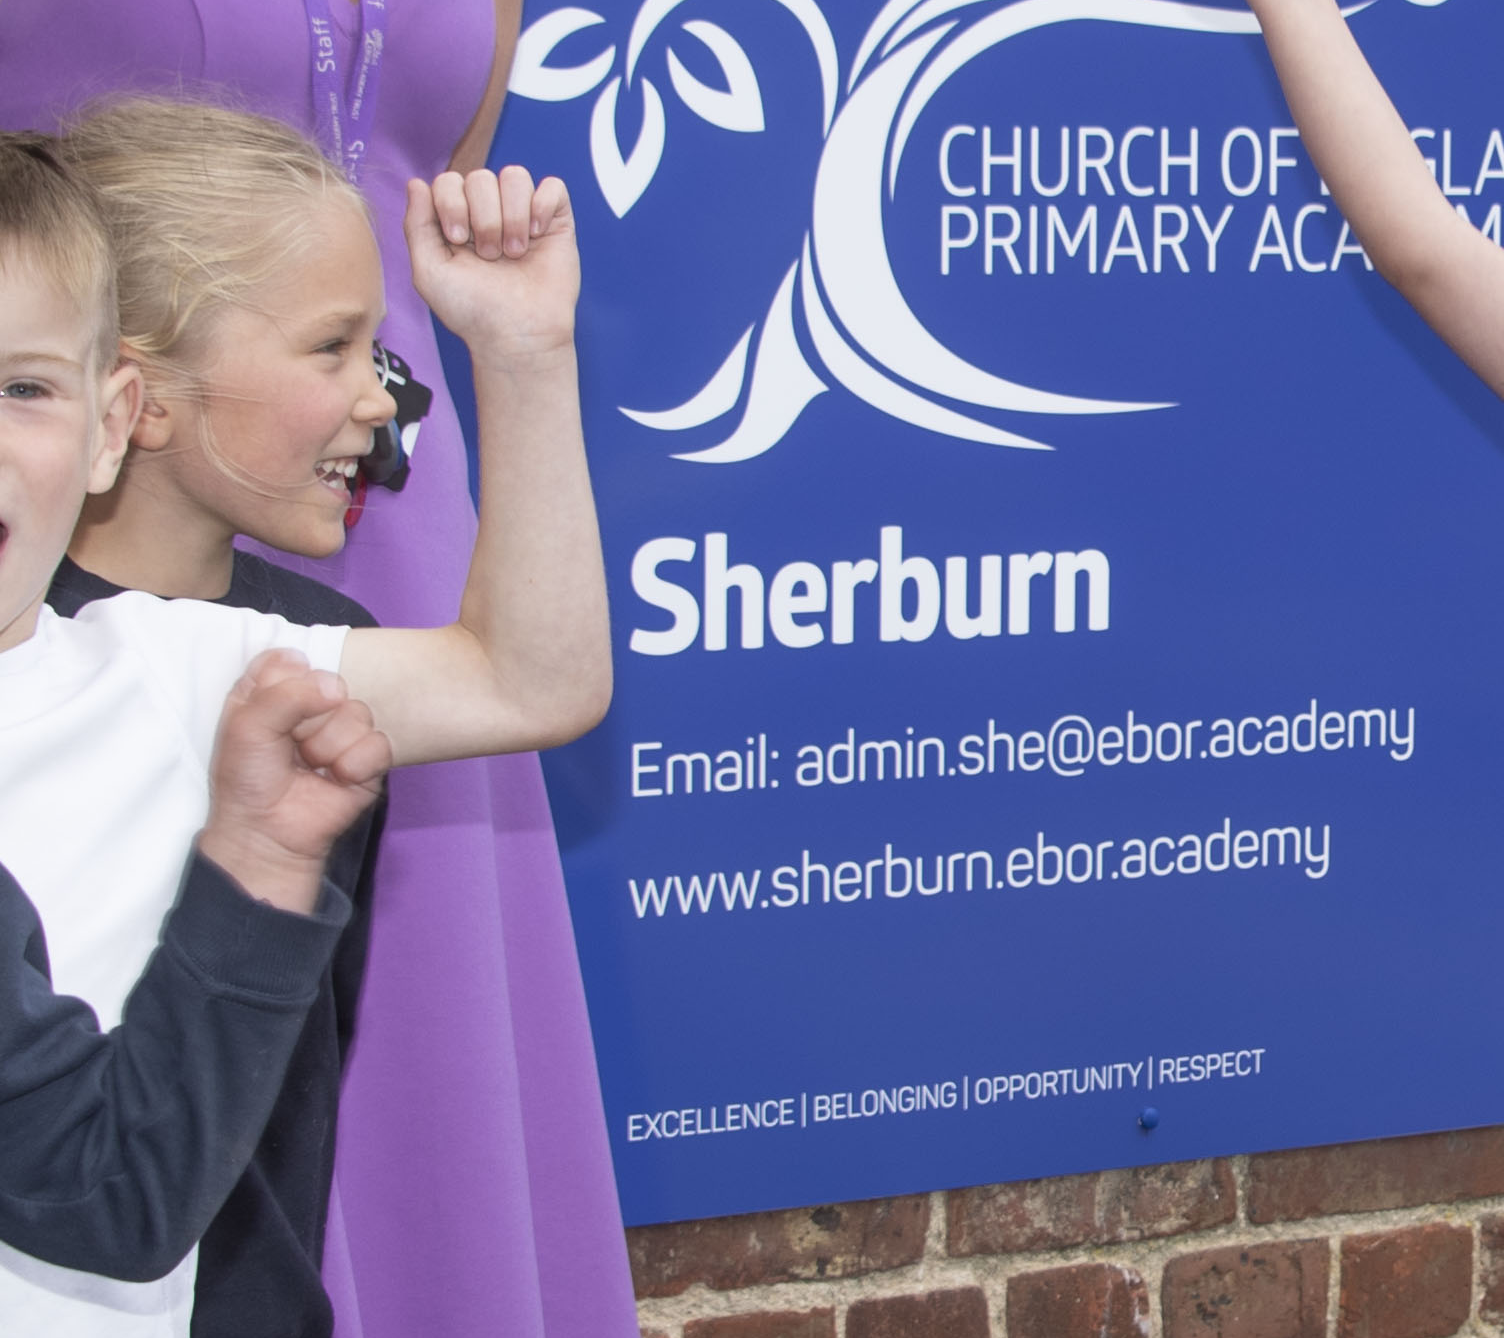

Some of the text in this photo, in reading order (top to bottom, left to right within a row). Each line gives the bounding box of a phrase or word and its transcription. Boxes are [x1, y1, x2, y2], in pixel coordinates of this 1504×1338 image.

[312, 17, 336, 73] Staff
[939, 125, 1199, 197] CHURCH
[1220, 127, 1299, 197] OF
[940, 204, 1235, 275] PRIMARY
[629, 526, 1110, 656] Sherburn
[631, 698, 1415, 798] Email: admin.she@ebor.academy
[628, 817, 1330, 918] www.sherburn.ebor.academy
[628, 1048, 1266, 1141] EXCELLENCE BELONGING OPPORTUNITY RESPECT
